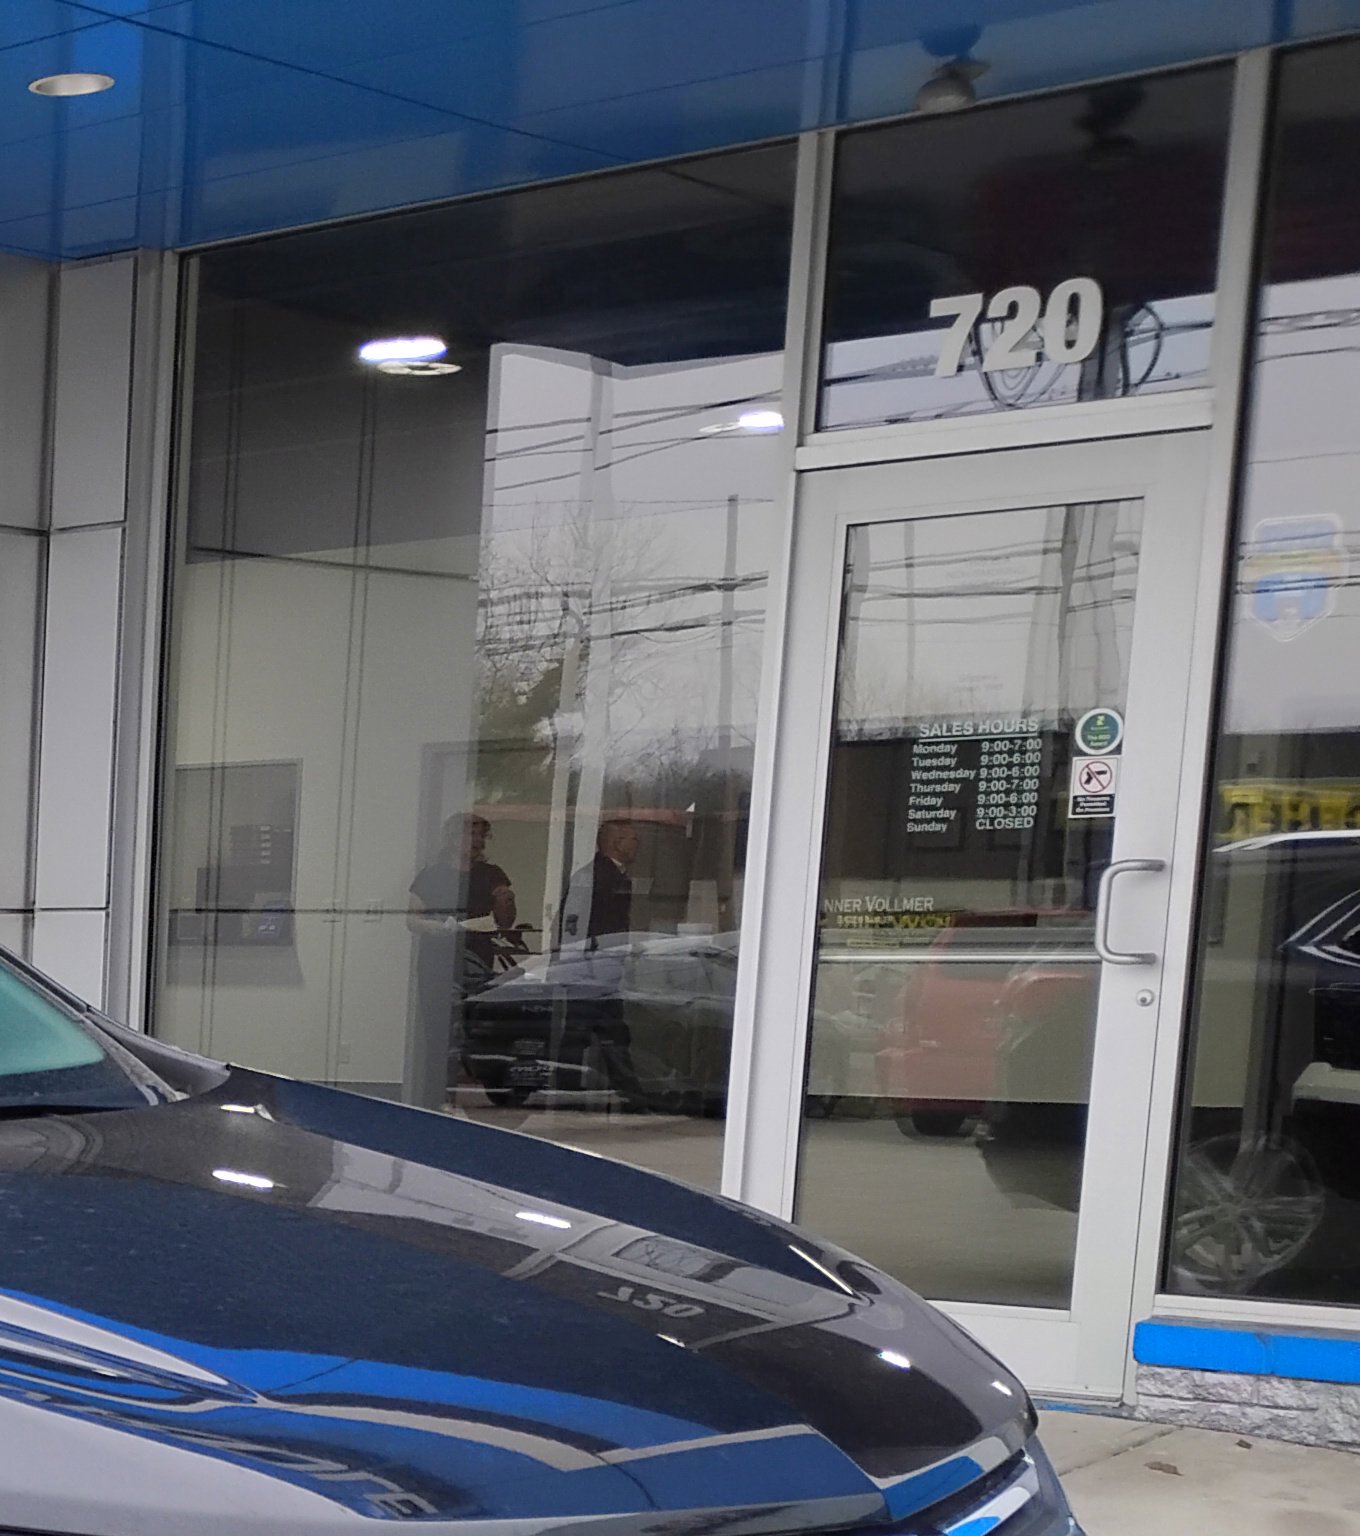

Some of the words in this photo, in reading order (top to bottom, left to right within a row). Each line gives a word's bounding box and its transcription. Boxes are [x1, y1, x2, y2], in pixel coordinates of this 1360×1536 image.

[929, 277, 1103, 378] 720
[920, 721, 974, 738] SALES
[978, 717, 1039, 734] HOURS
[912, 743, 958, 755] Monday
[911, 756, 958, 768] Tuesday
[911, 768, 977, 780] Wednesday
[909, 782, 962, 794] Thursday
[908, 796, 944, 807] Friday
[907, 808, 958, 820] Saturday
[906, 821, 948, 833] Sunday
[975, 816, 1035, 830] CLOSED
[864, 894, 935, 913] VOLLMER
